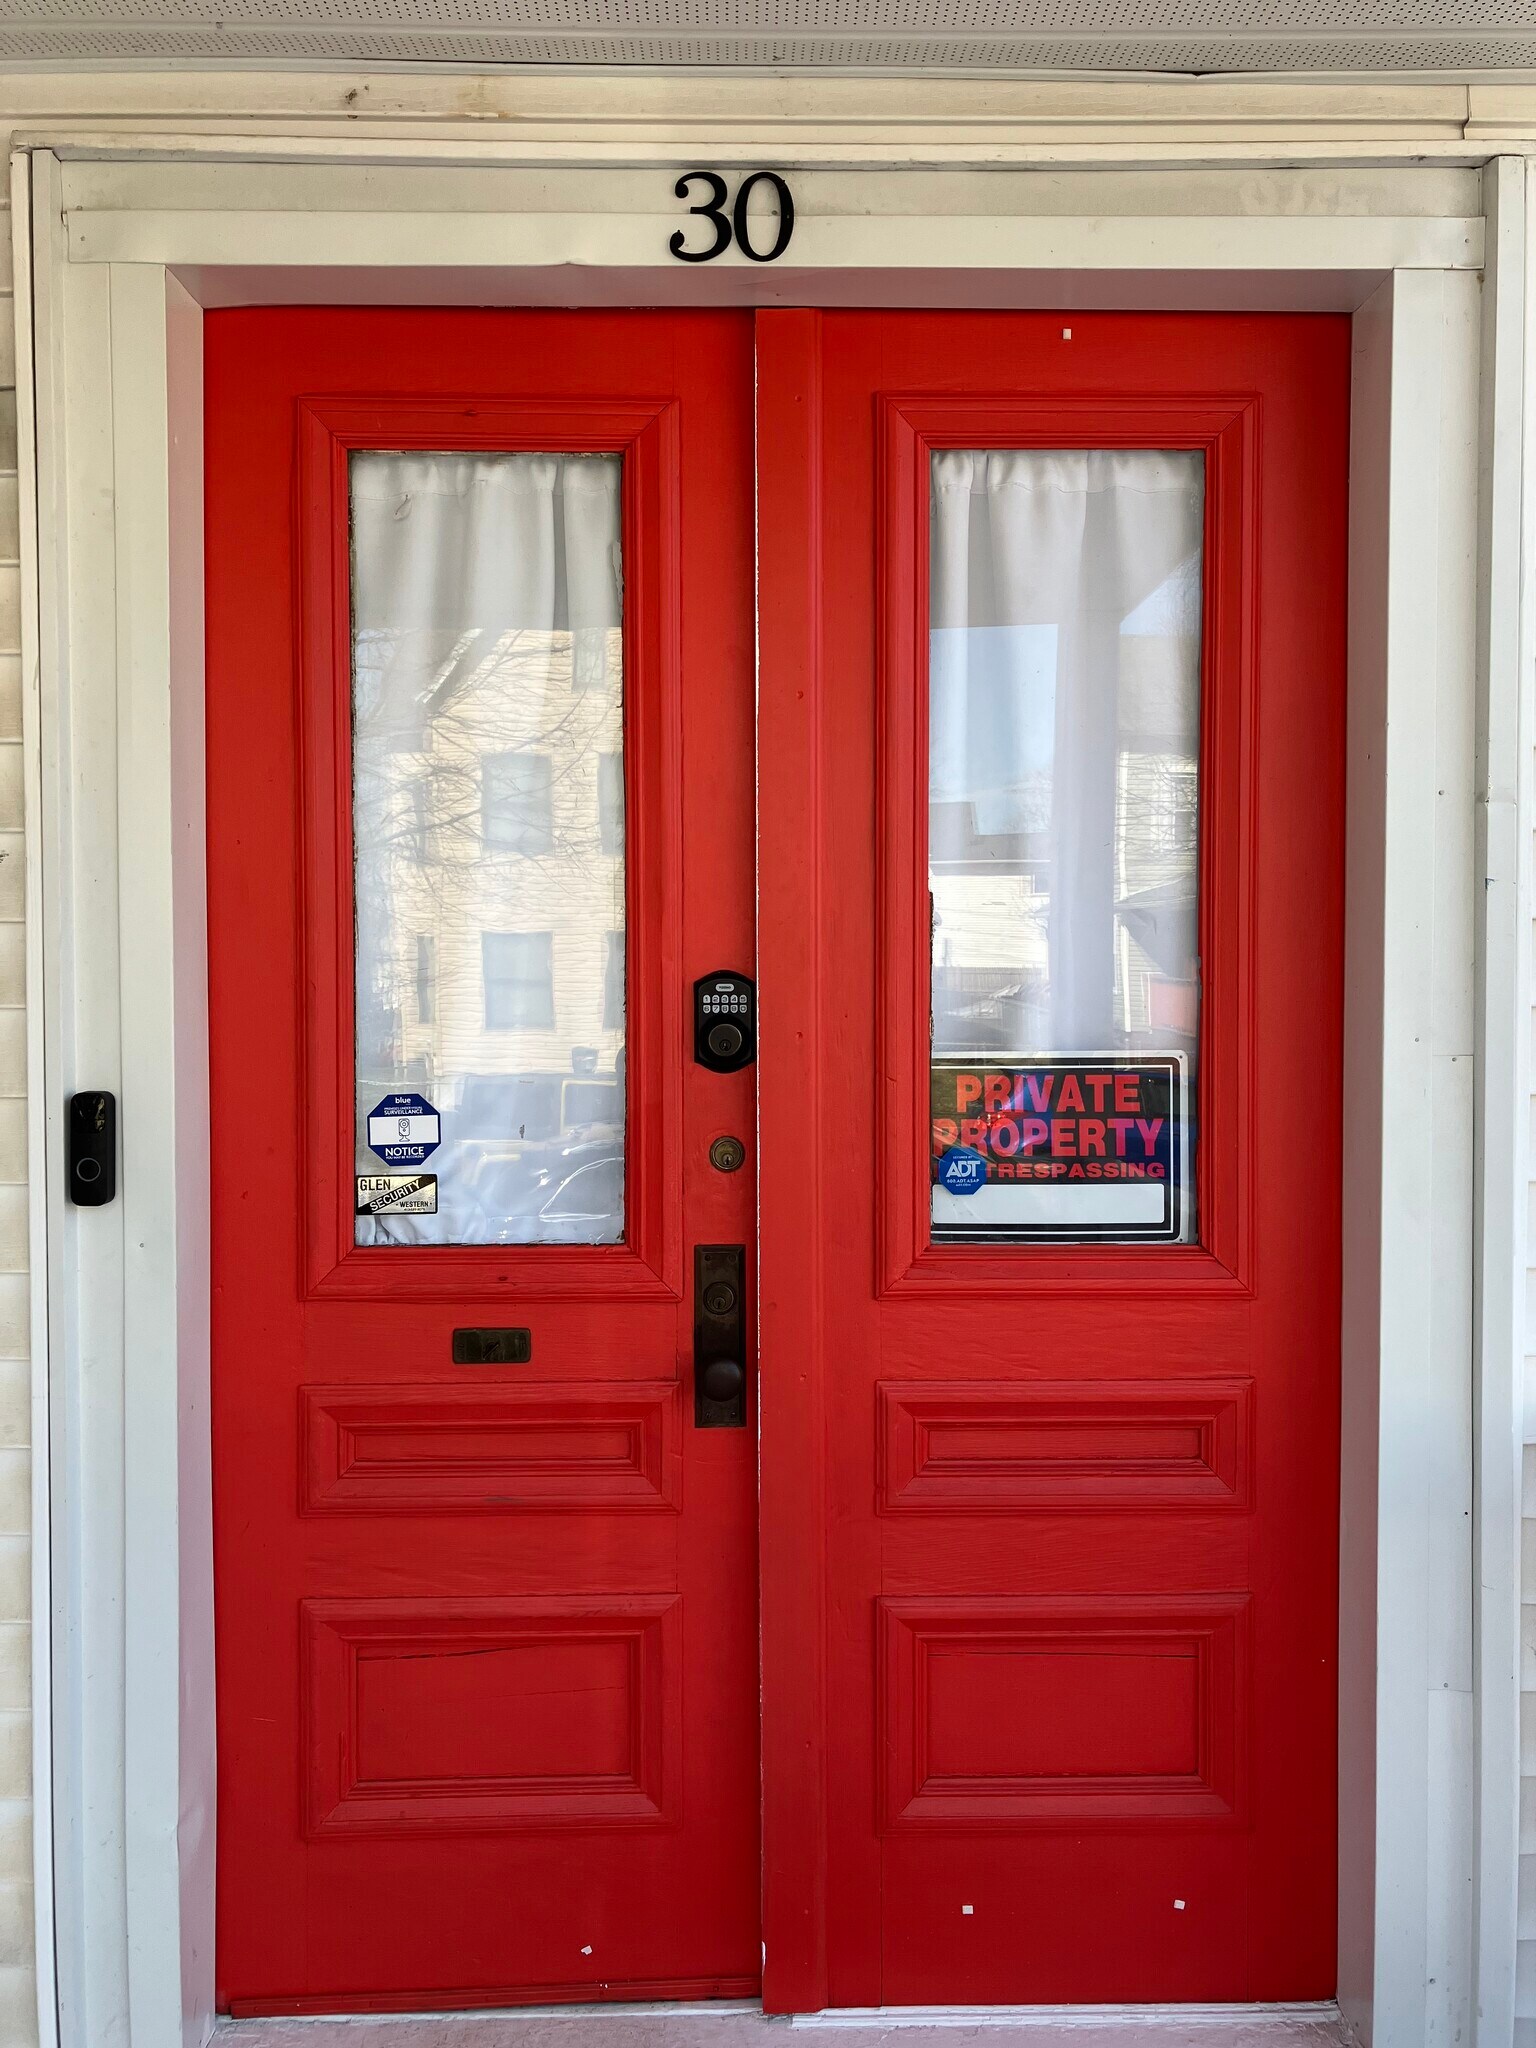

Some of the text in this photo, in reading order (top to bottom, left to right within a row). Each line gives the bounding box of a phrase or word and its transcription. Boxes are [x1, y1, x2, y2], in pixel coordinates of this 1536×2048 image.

[669, 171, 795, 263] 30
[394, 1096, 412, 1104] blue
[955, 1074, 1140, 1113] PRIVATE
[933, 1118, 1164, 1158] PROPERTY
[385, 1146, 425, 1157] NOTICE
[945, 1160, 981, 1178] ADT
[986, 1162, 1165, 1179] TRESPASSING
[359, 1178, 391, 1191] GLEN
[369, 1179, 421, 1211] SECURITY
